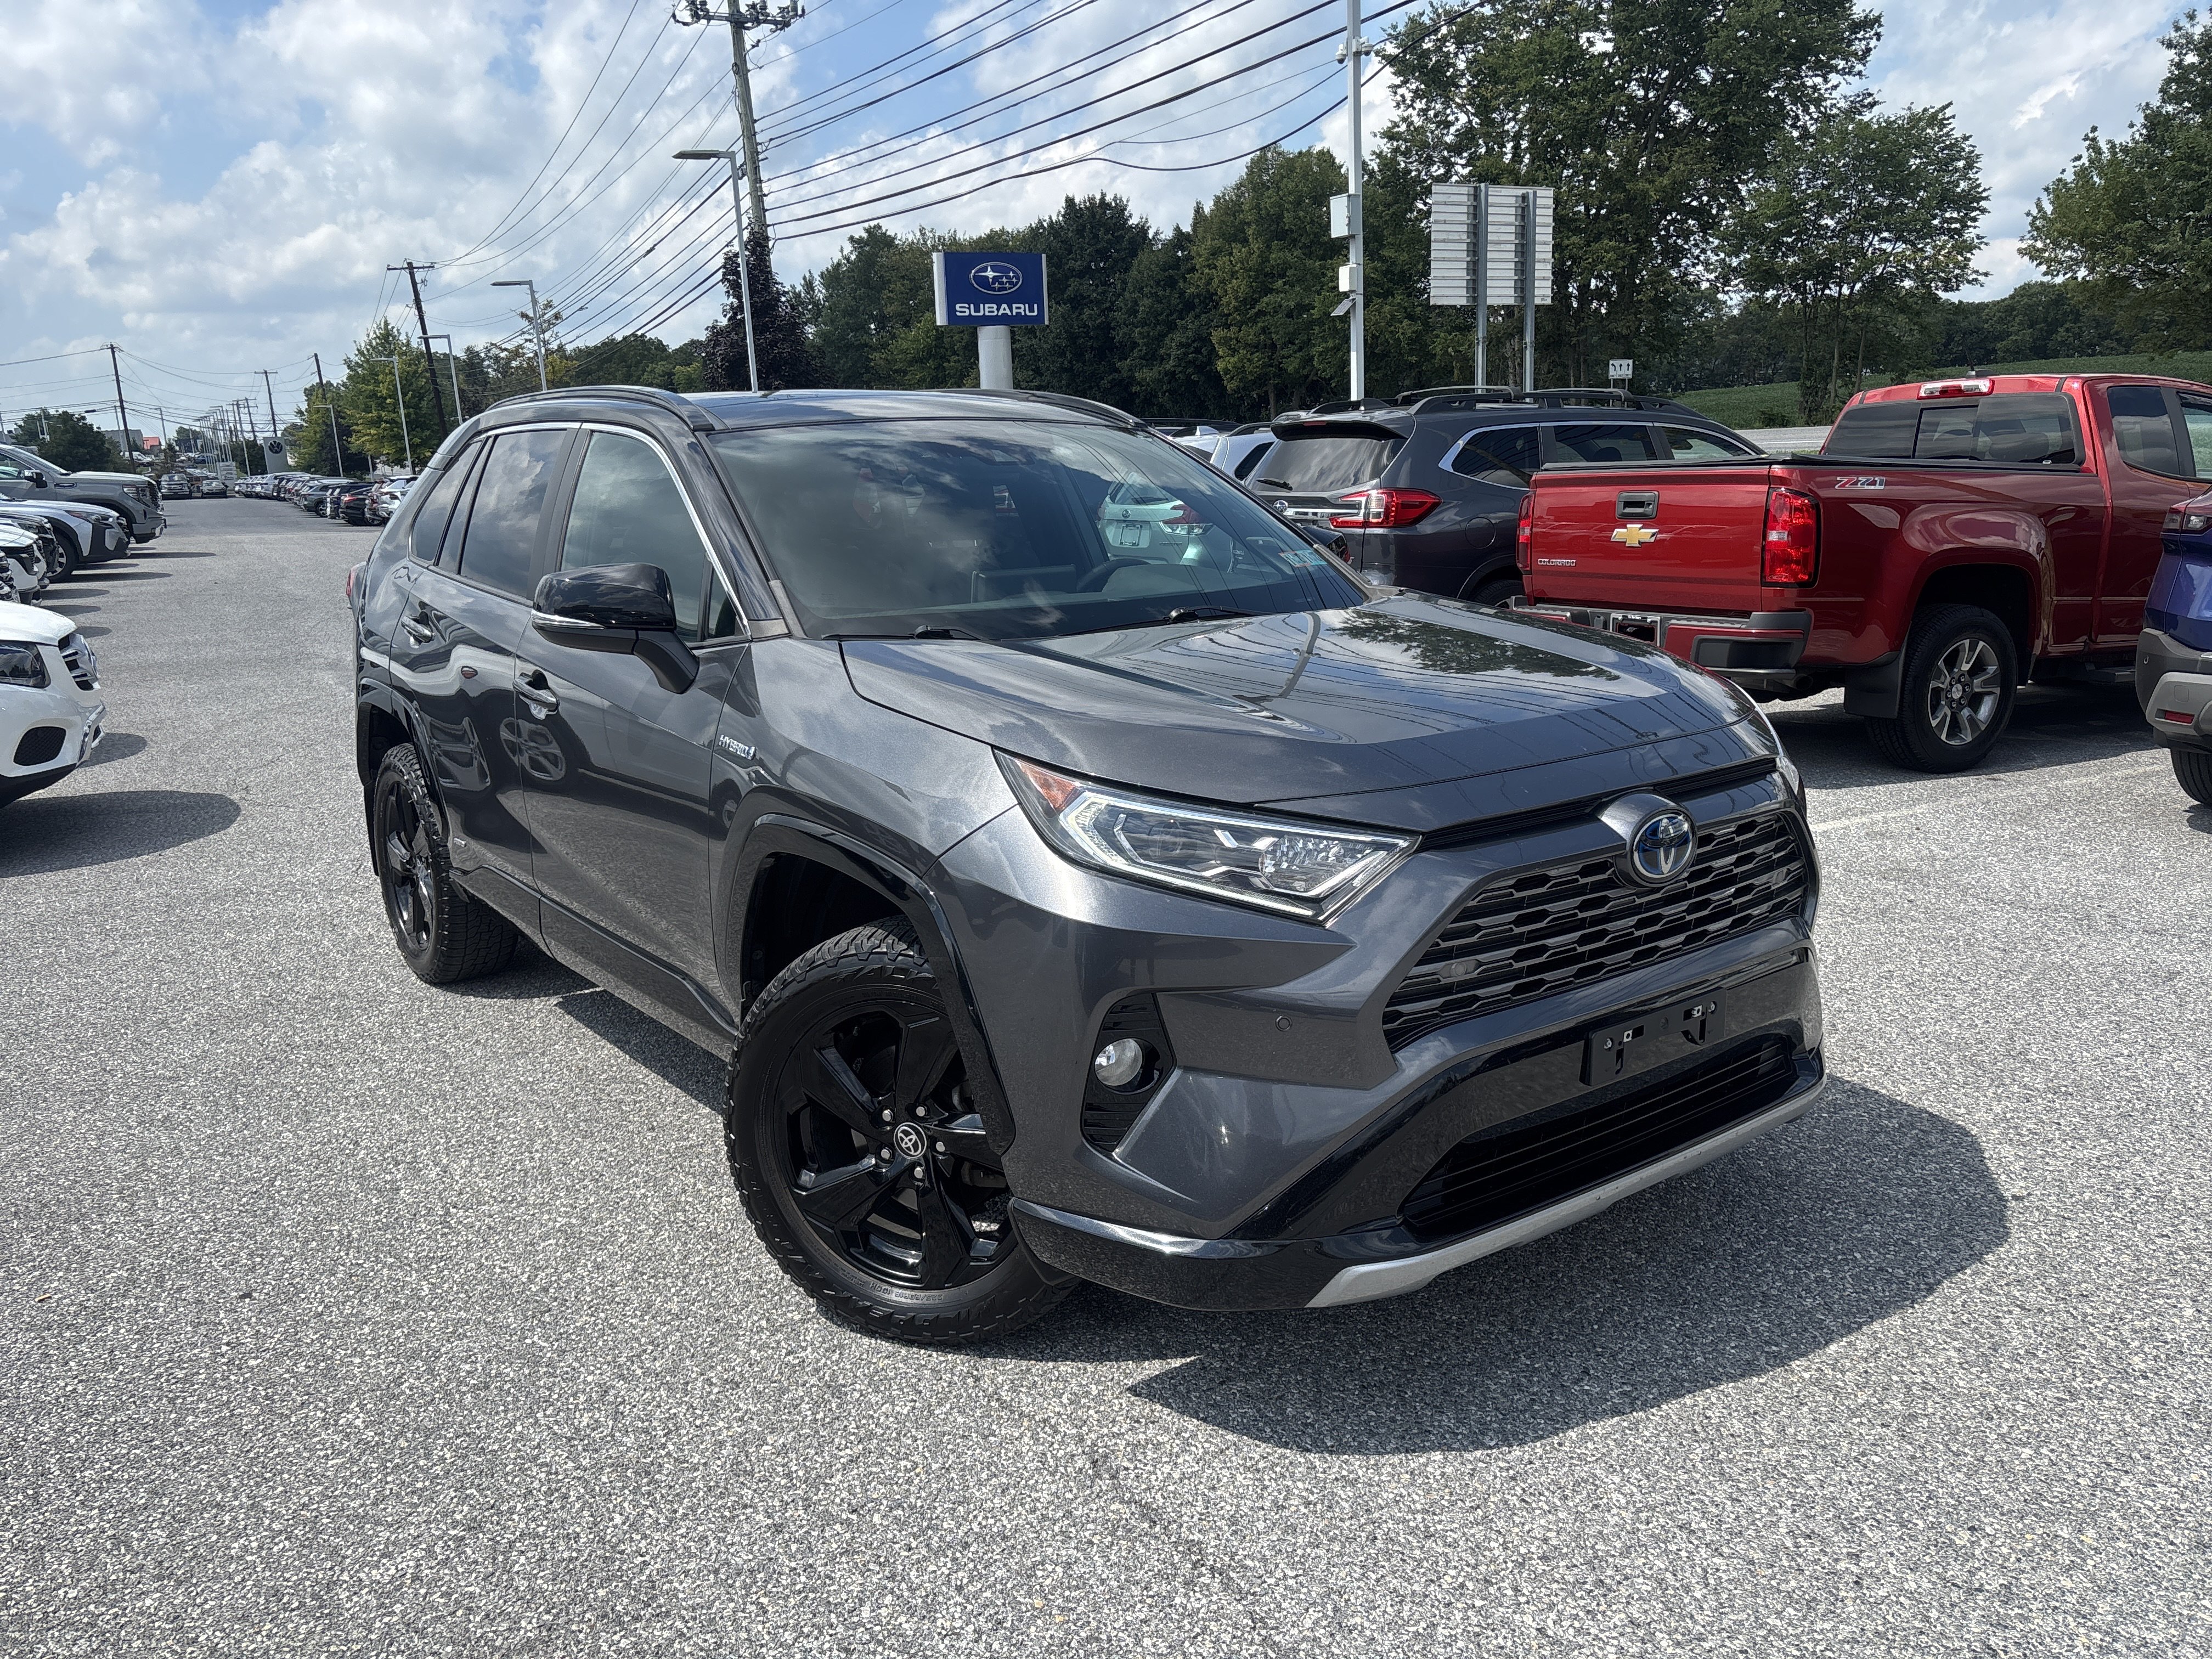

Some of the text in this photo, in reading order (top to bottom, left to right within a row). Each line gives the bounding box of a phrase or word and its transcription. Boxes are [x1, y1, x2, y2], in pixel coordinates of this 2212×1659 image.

[956, 303, 1038, 316] SUBARU
[1835, 477, 1886, 489] Z71
[718, 734, 750, 758] HYBRID
